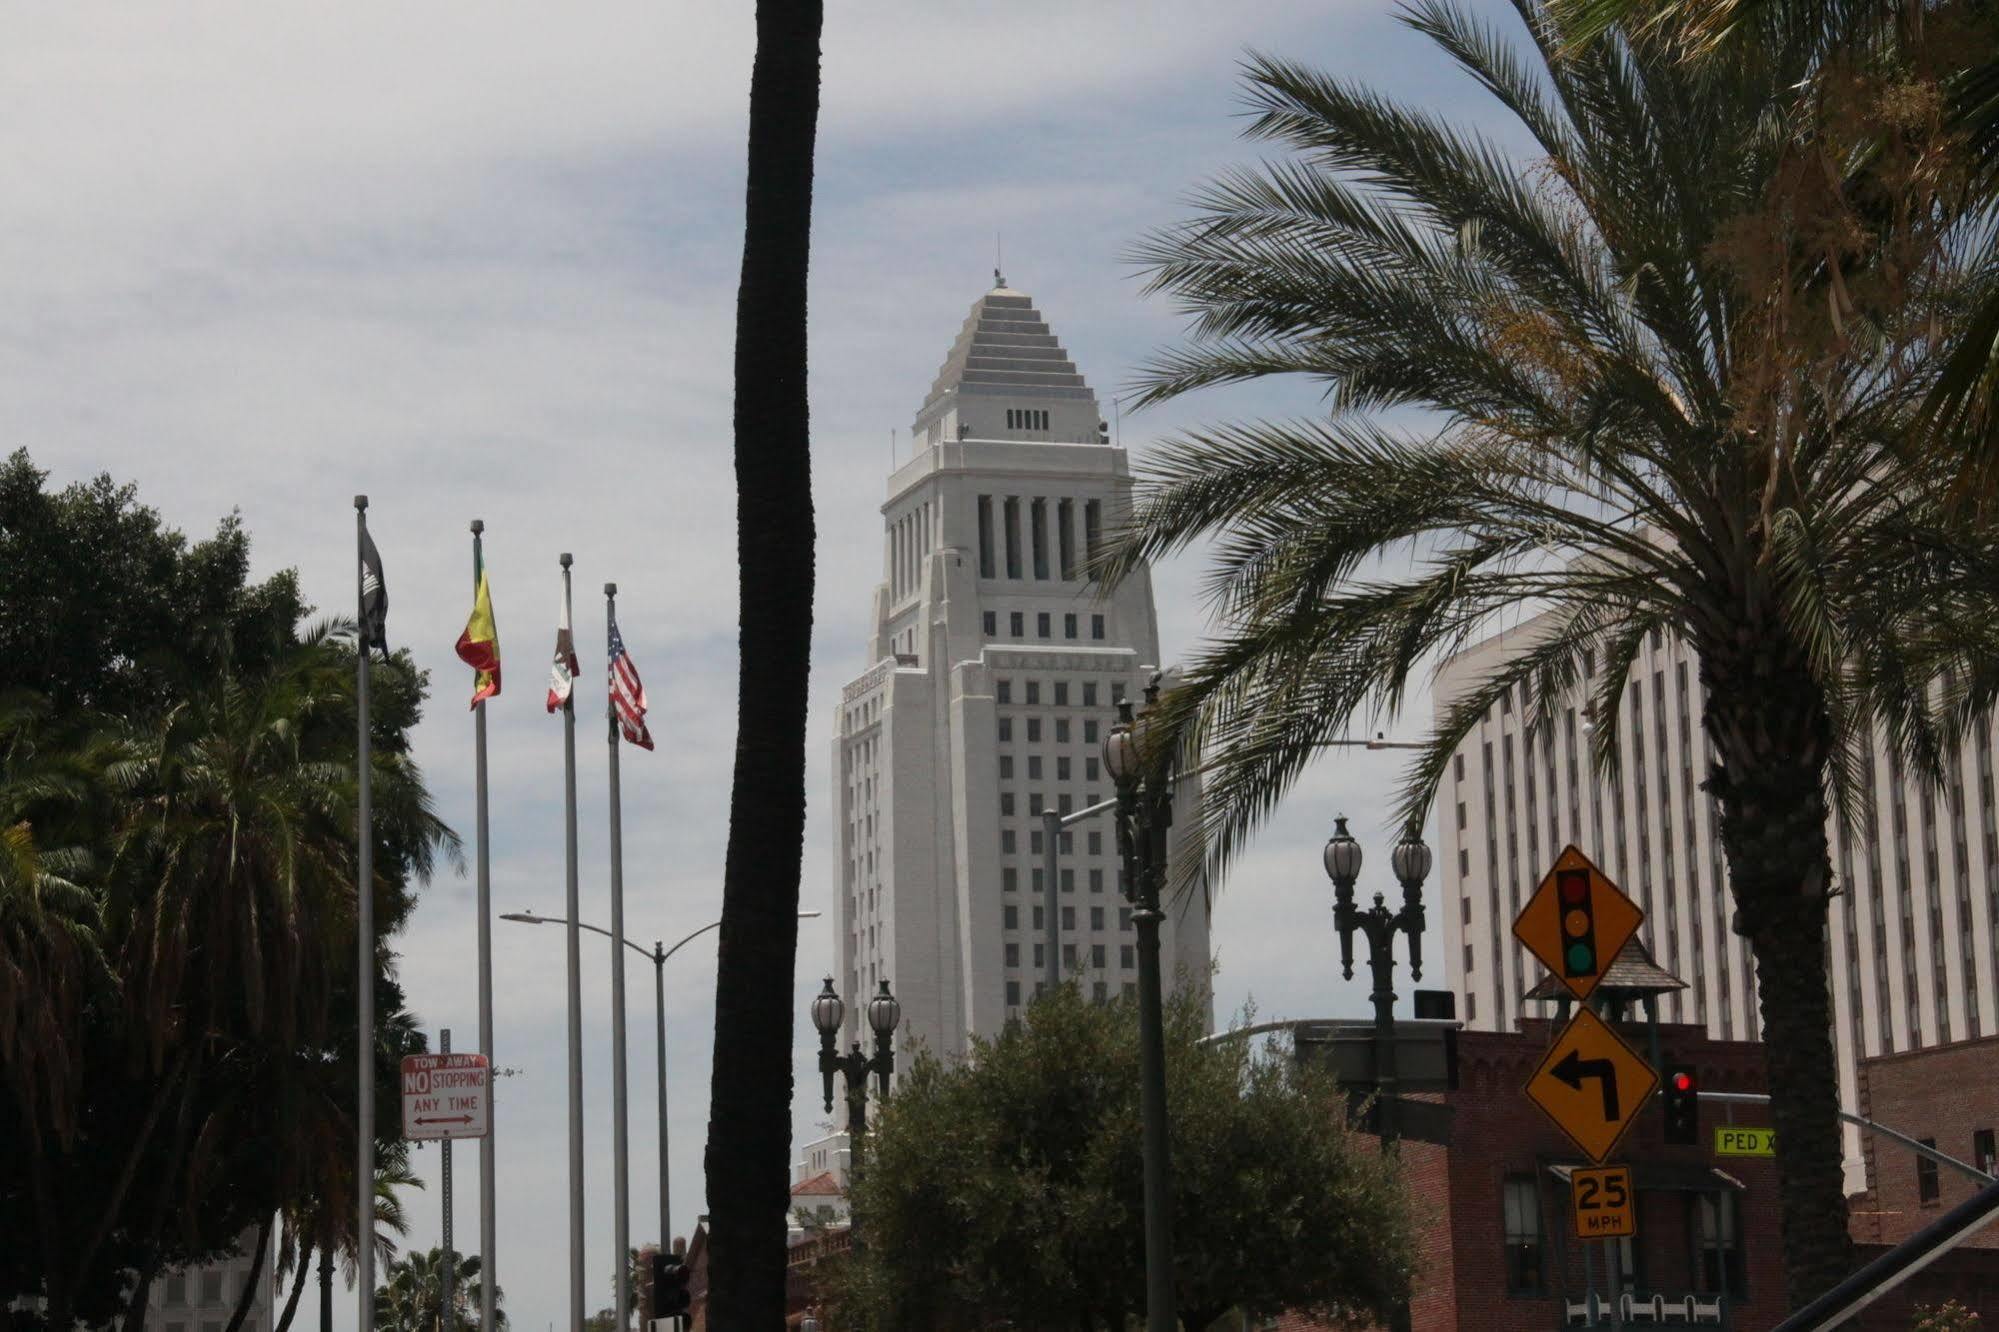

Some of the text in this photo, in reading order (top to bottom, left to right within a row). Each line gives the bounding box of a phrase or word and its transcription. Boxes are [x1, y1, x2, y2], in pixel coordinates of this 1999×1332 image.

[405, 1071, 485, 1093] NO STOPPING
[414, 1096, 478, 1113] ANY TIME
[1724, 1133, 1758, 1150] PED
[1577, 1175, 1626, 1210] 25
[1588, 1216, 1622, 1231] MPH
